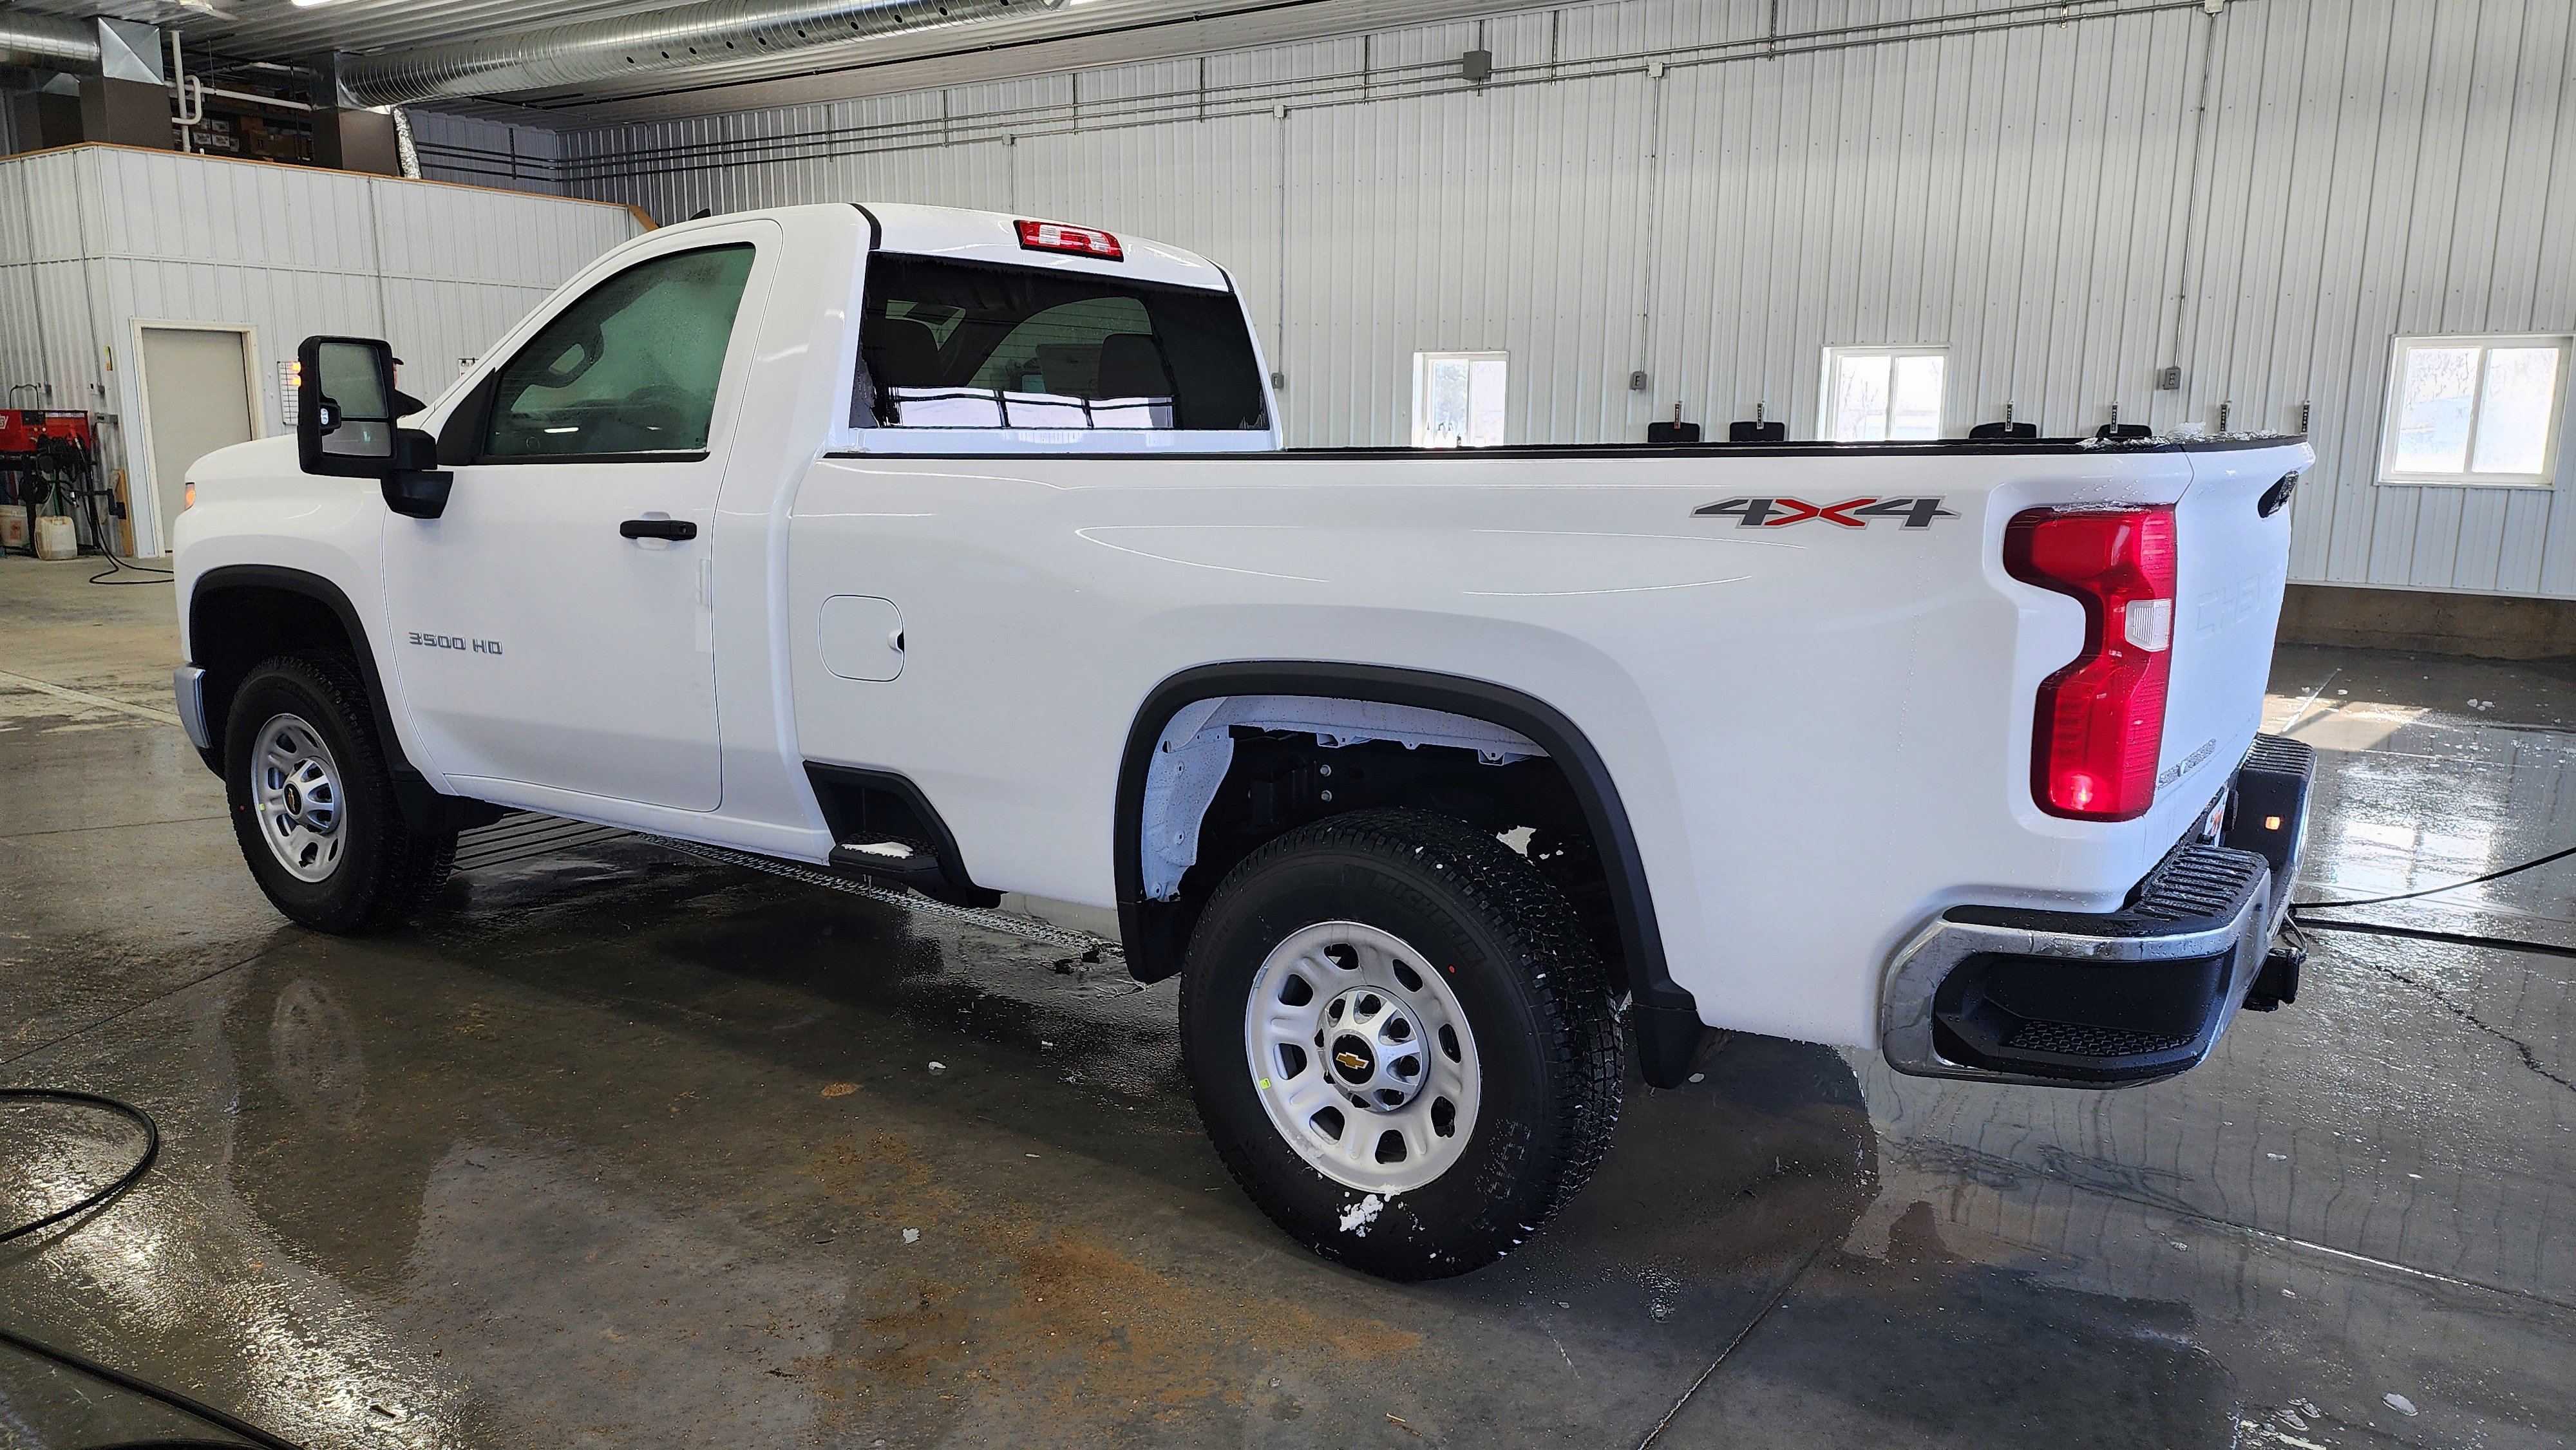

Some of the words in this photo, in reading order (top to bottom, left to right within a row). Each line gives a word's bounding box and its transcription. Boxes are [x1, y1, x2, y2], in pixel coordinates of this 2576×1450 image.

[409, 632, 466, 650] 3500
[472, 638, 503, 655] HD
[1372, 872, 1486, 965] MICHELIN
